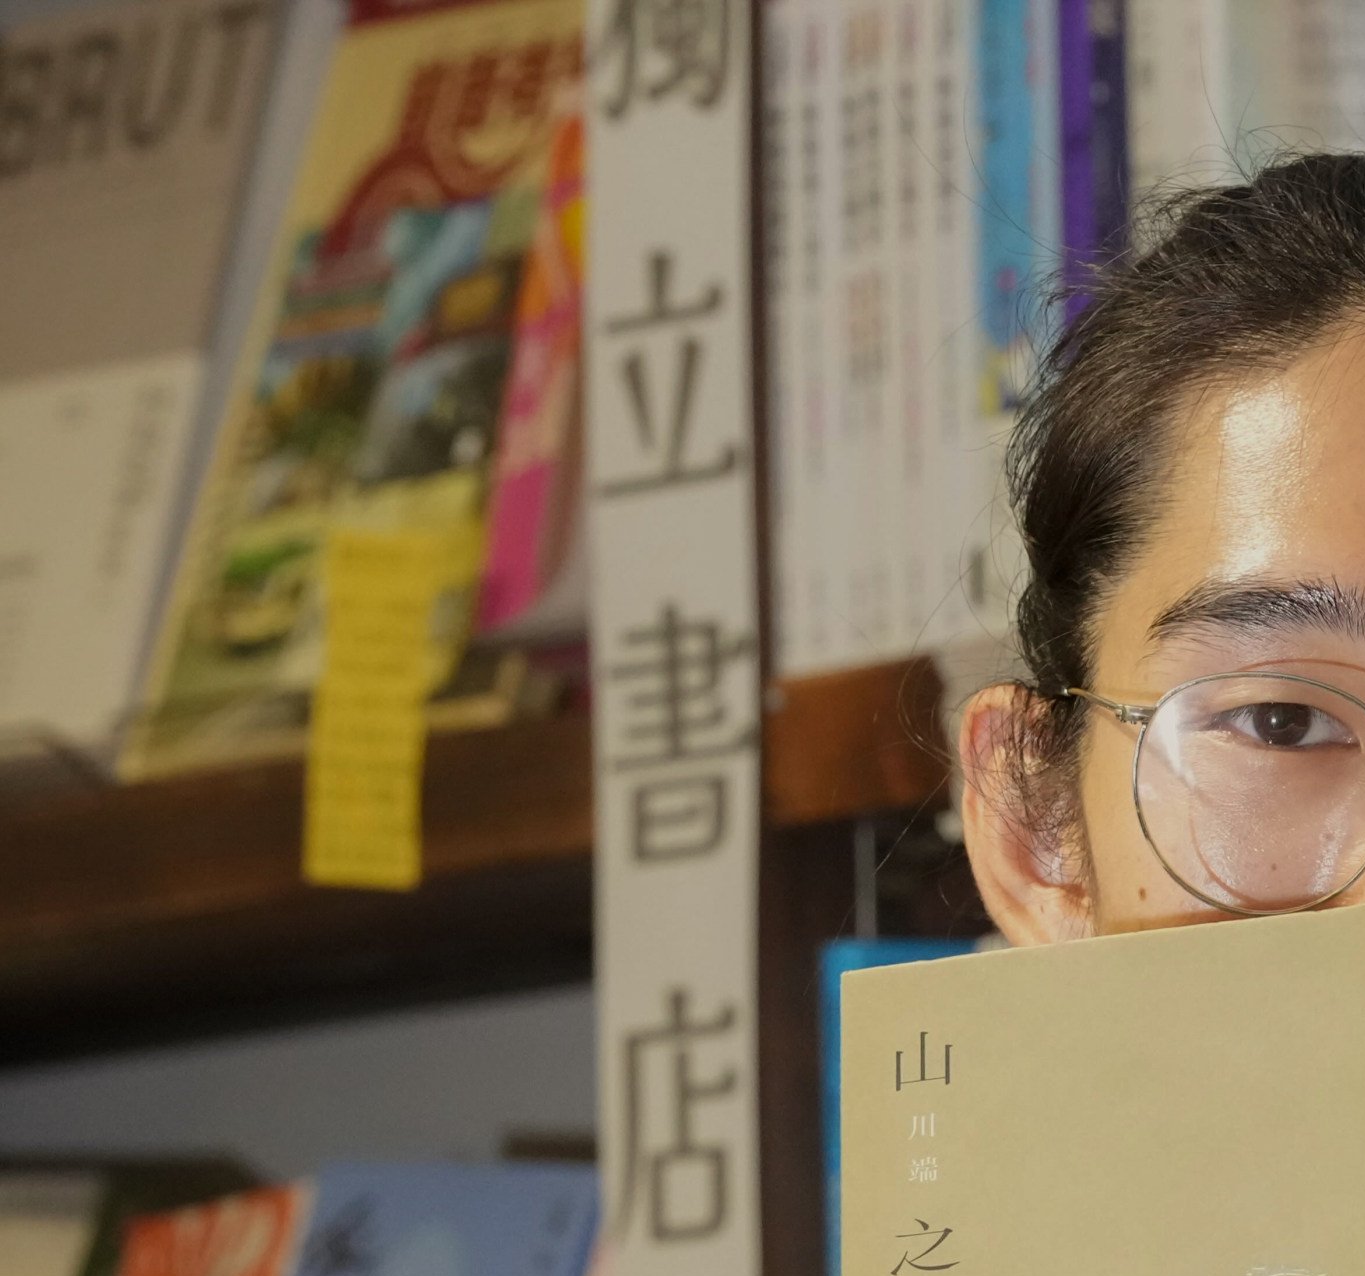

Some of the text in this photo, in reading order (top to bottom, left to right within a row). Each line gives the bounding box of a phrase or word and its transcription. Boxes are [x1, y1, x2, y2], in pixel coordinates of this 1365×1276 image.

[895, 1031, 953, 1091] 山
[907, 1112, 939, 1184] 川端
[890, 1218, 961, 1276] 之
